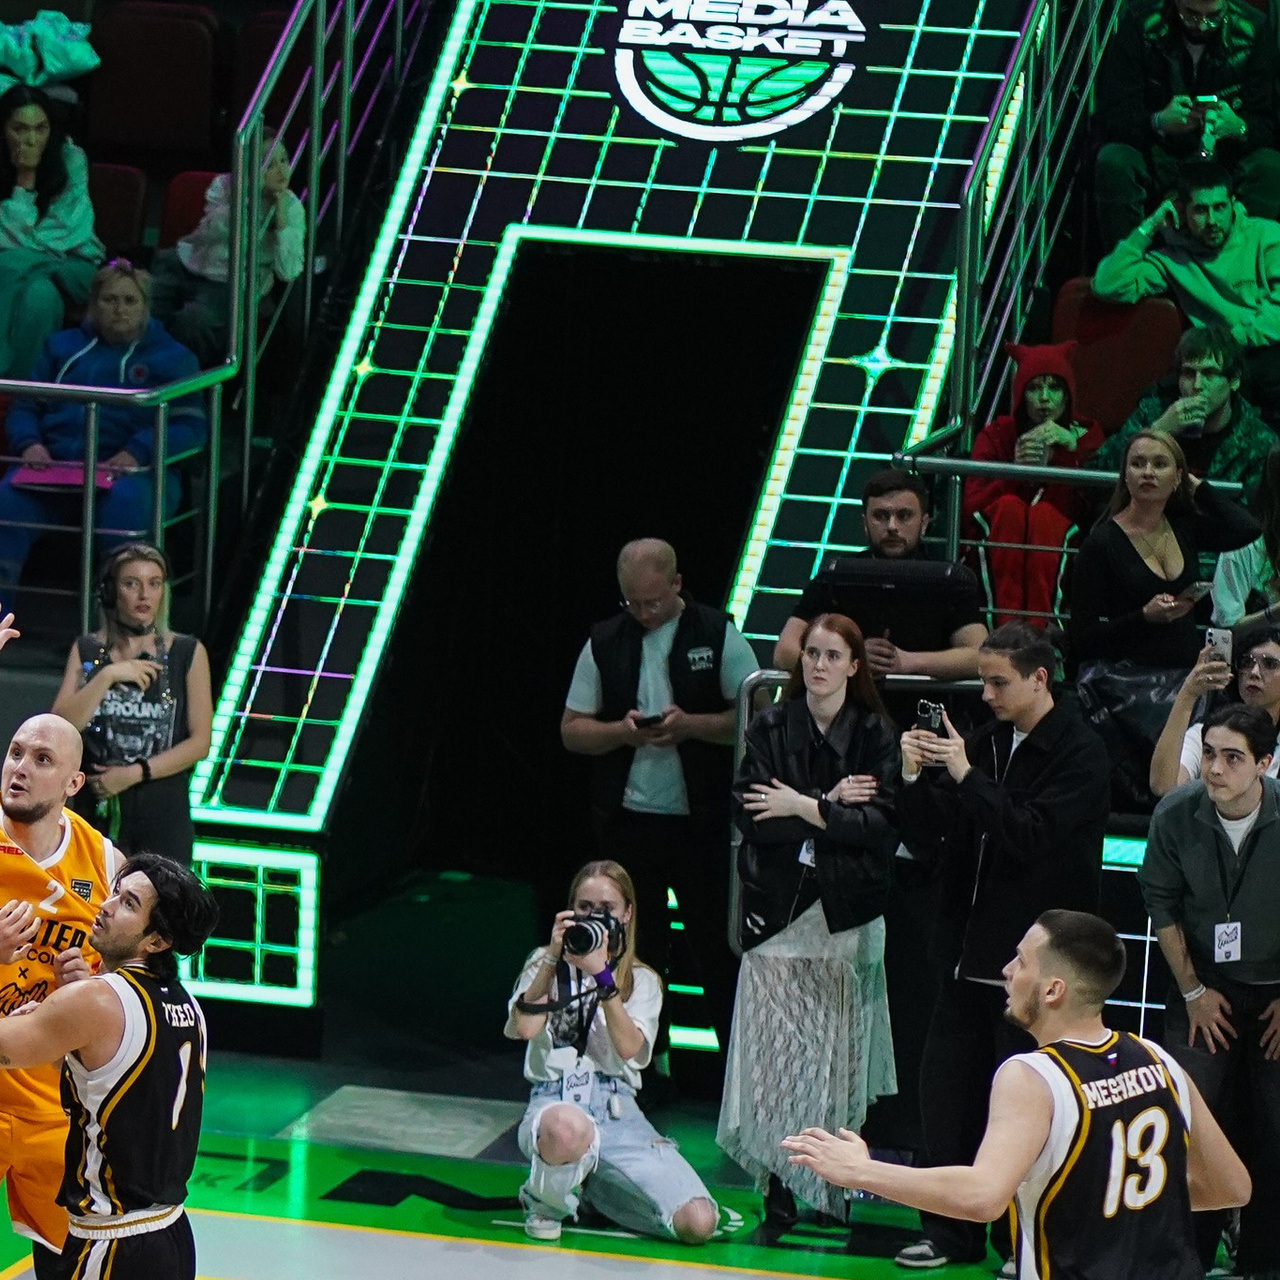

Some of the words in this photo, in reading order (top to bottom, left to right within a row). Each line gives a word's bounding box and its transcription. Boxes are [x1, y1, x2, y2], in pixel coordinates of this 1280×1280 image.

[617, 19, 867, 58] BASKET
[38, 879, 66, 915] 2
[171, 1040, 192, 1131] 1
[1103, 1105, 1170, 1219] 13
